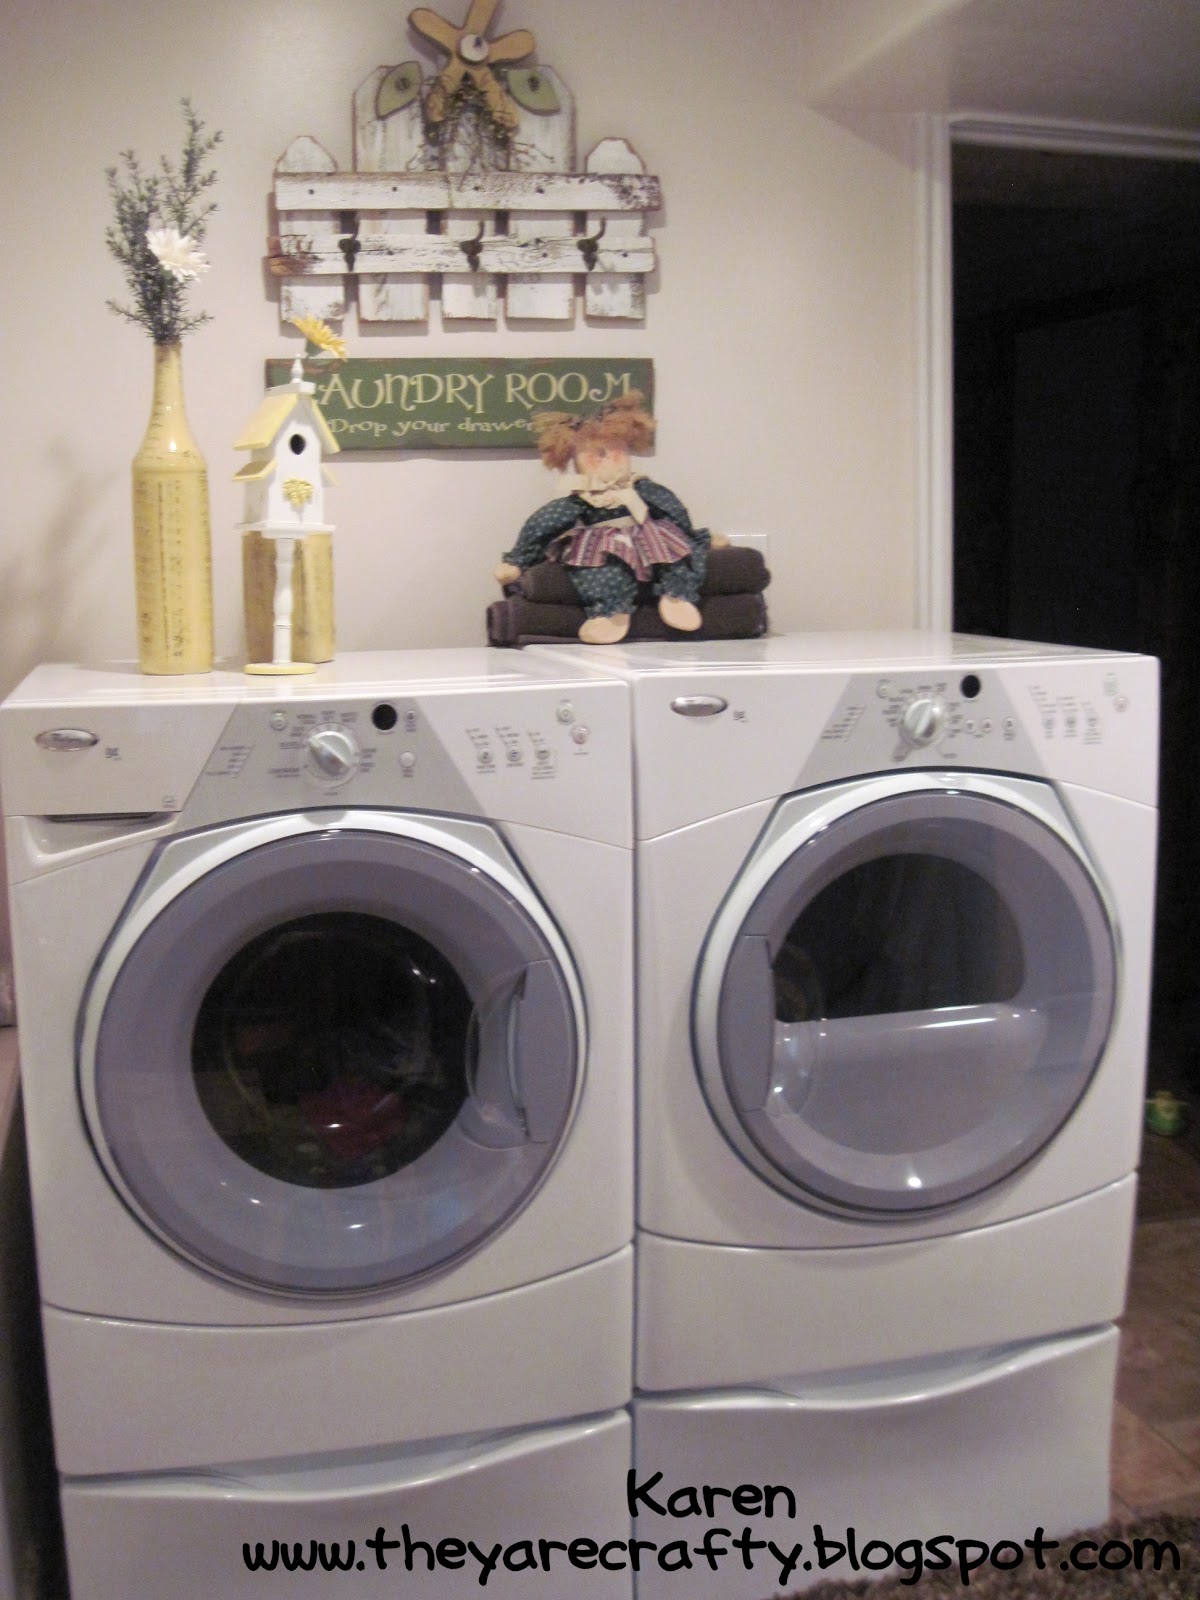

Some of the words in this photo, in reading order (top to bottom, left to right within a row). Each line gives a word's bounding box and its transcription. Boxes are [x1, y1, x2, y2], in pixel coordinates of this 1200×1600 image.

[317, 372, 495, 413] AUNDRY
[504, 372, 631, 409] ROOM
[327, 418, 389, 437] Drop
[391, 420, 451, 437] your
